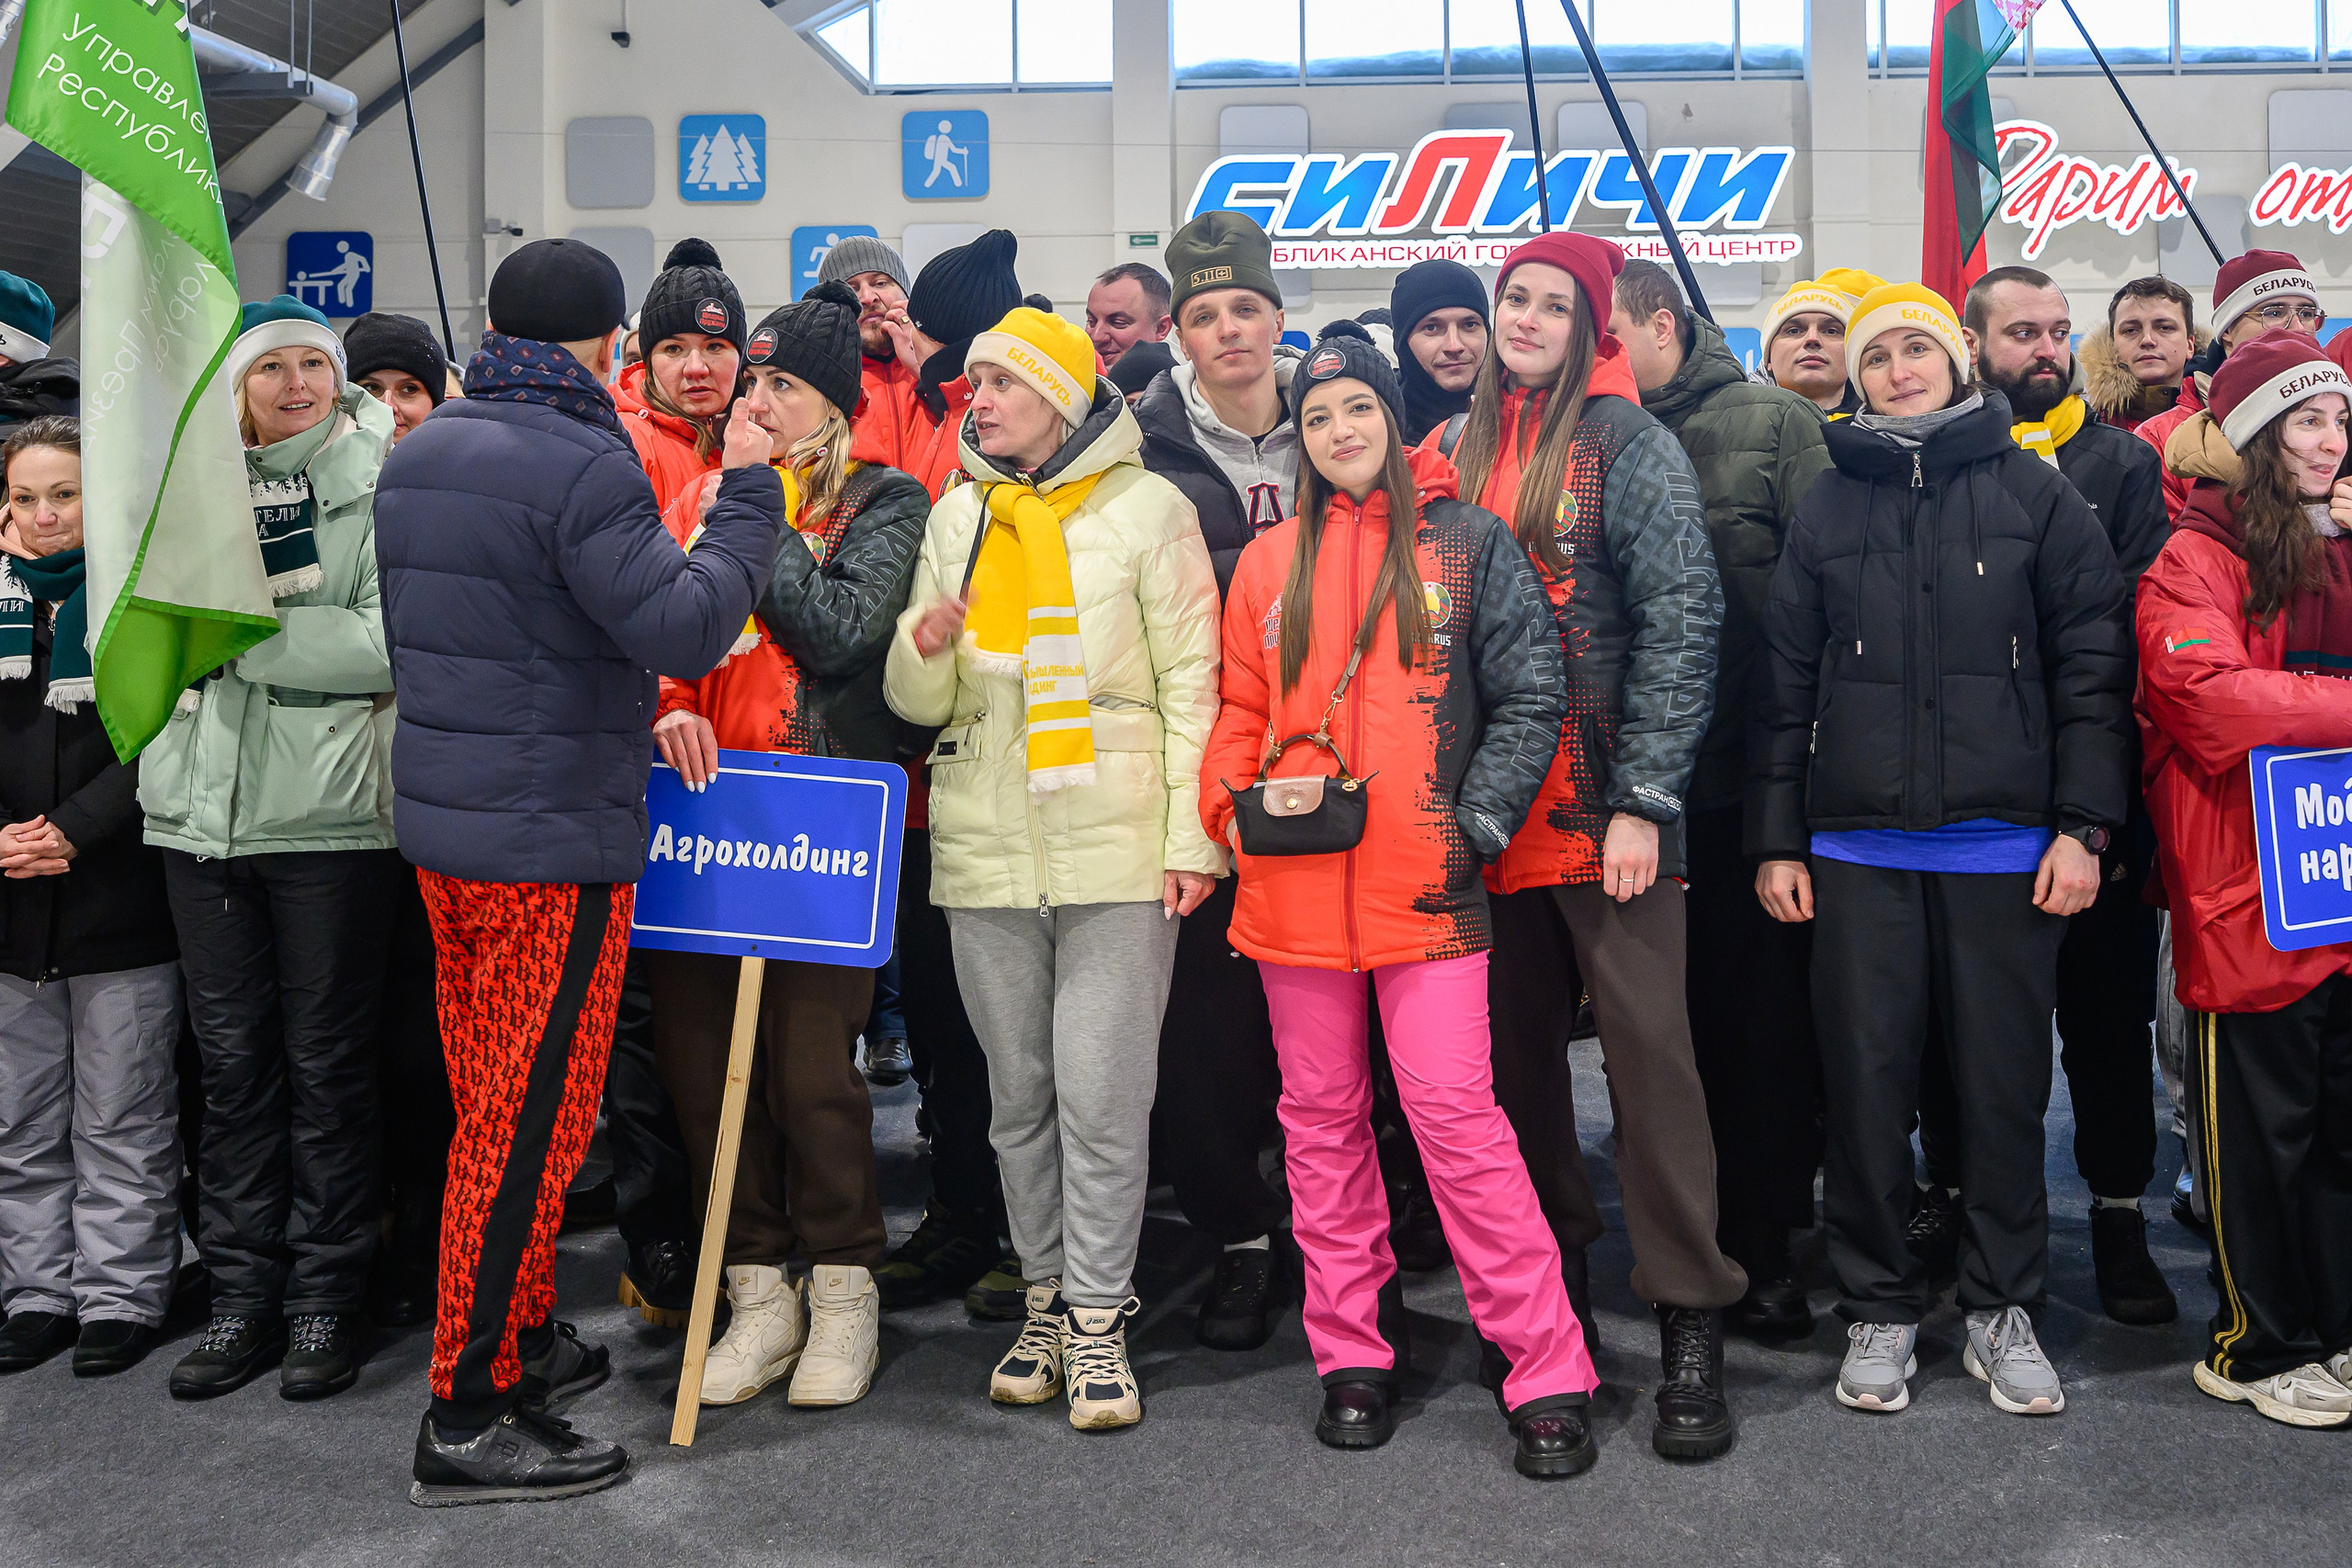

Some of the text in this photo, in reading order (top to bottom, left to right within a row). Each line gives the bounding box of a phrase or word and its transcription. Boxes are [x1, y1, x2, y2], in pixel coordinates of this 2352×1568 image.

[1708, 241, 1796, 260] ЦЕНТР
[1006, 346, 1071, 406] БЕЛАРУСЬ
[1029, 661, 1084, 679] ЫШЛЕННЫЙ
[1029, 681, 1057, 696] ДИНГ
[649, 823, 869, 877] Агрохолдинг
